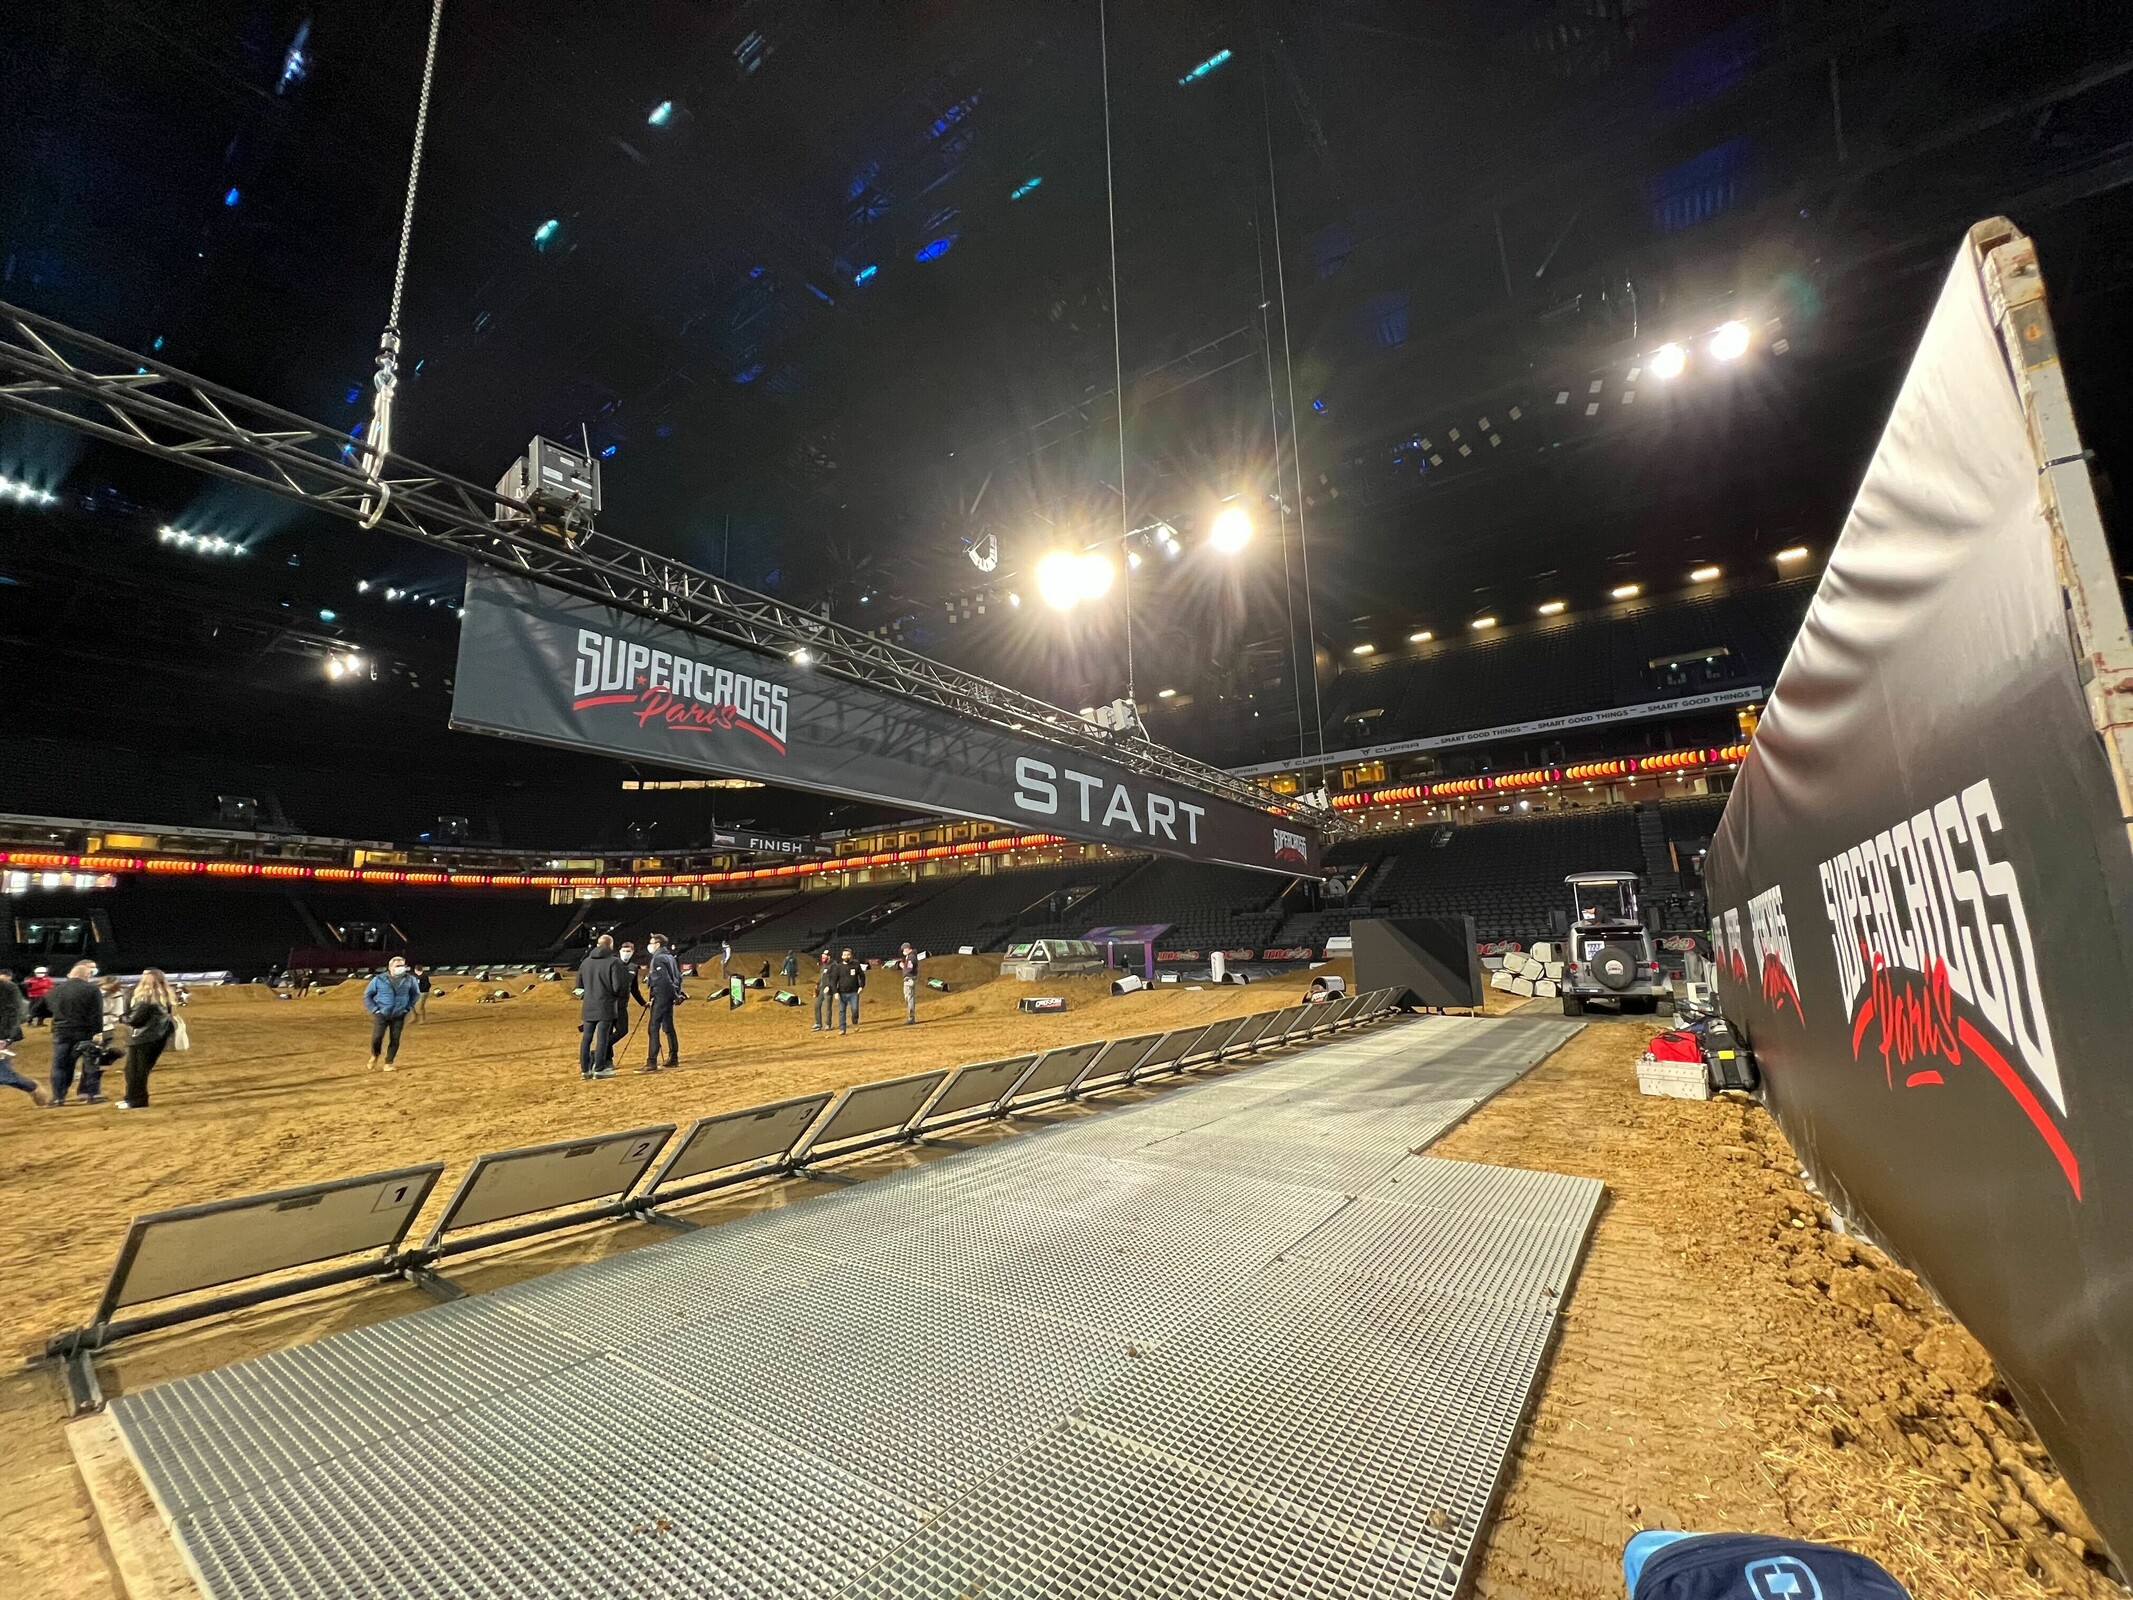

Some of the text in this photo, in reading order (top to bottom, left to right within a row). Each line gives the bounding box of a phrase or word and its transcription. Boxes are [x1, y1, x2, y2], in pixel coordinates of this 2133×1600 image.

[573, 628, 788, 744] SUPERCROSS
[633, 685, 737, 729] Paris
[1647, 690, 1751, 712] SMART GOOD THINGS
[1538, 709, 1629, 729] SMART GOOD THINGS
[1440, 726, 1522, 744] SMART GOOD THINGS
[1013, 756, 1206, 845] START
[749, 837, 802, 853] FINISH
[1818, 777, 2067, 1118] SUPERCROSS
[1872, 950, 1961, 1091] Paris
[799, 1107, 814, 1120] 3
[631, 1142, 651, 1158] 2
[393, 1185, 409, 1203] 1
